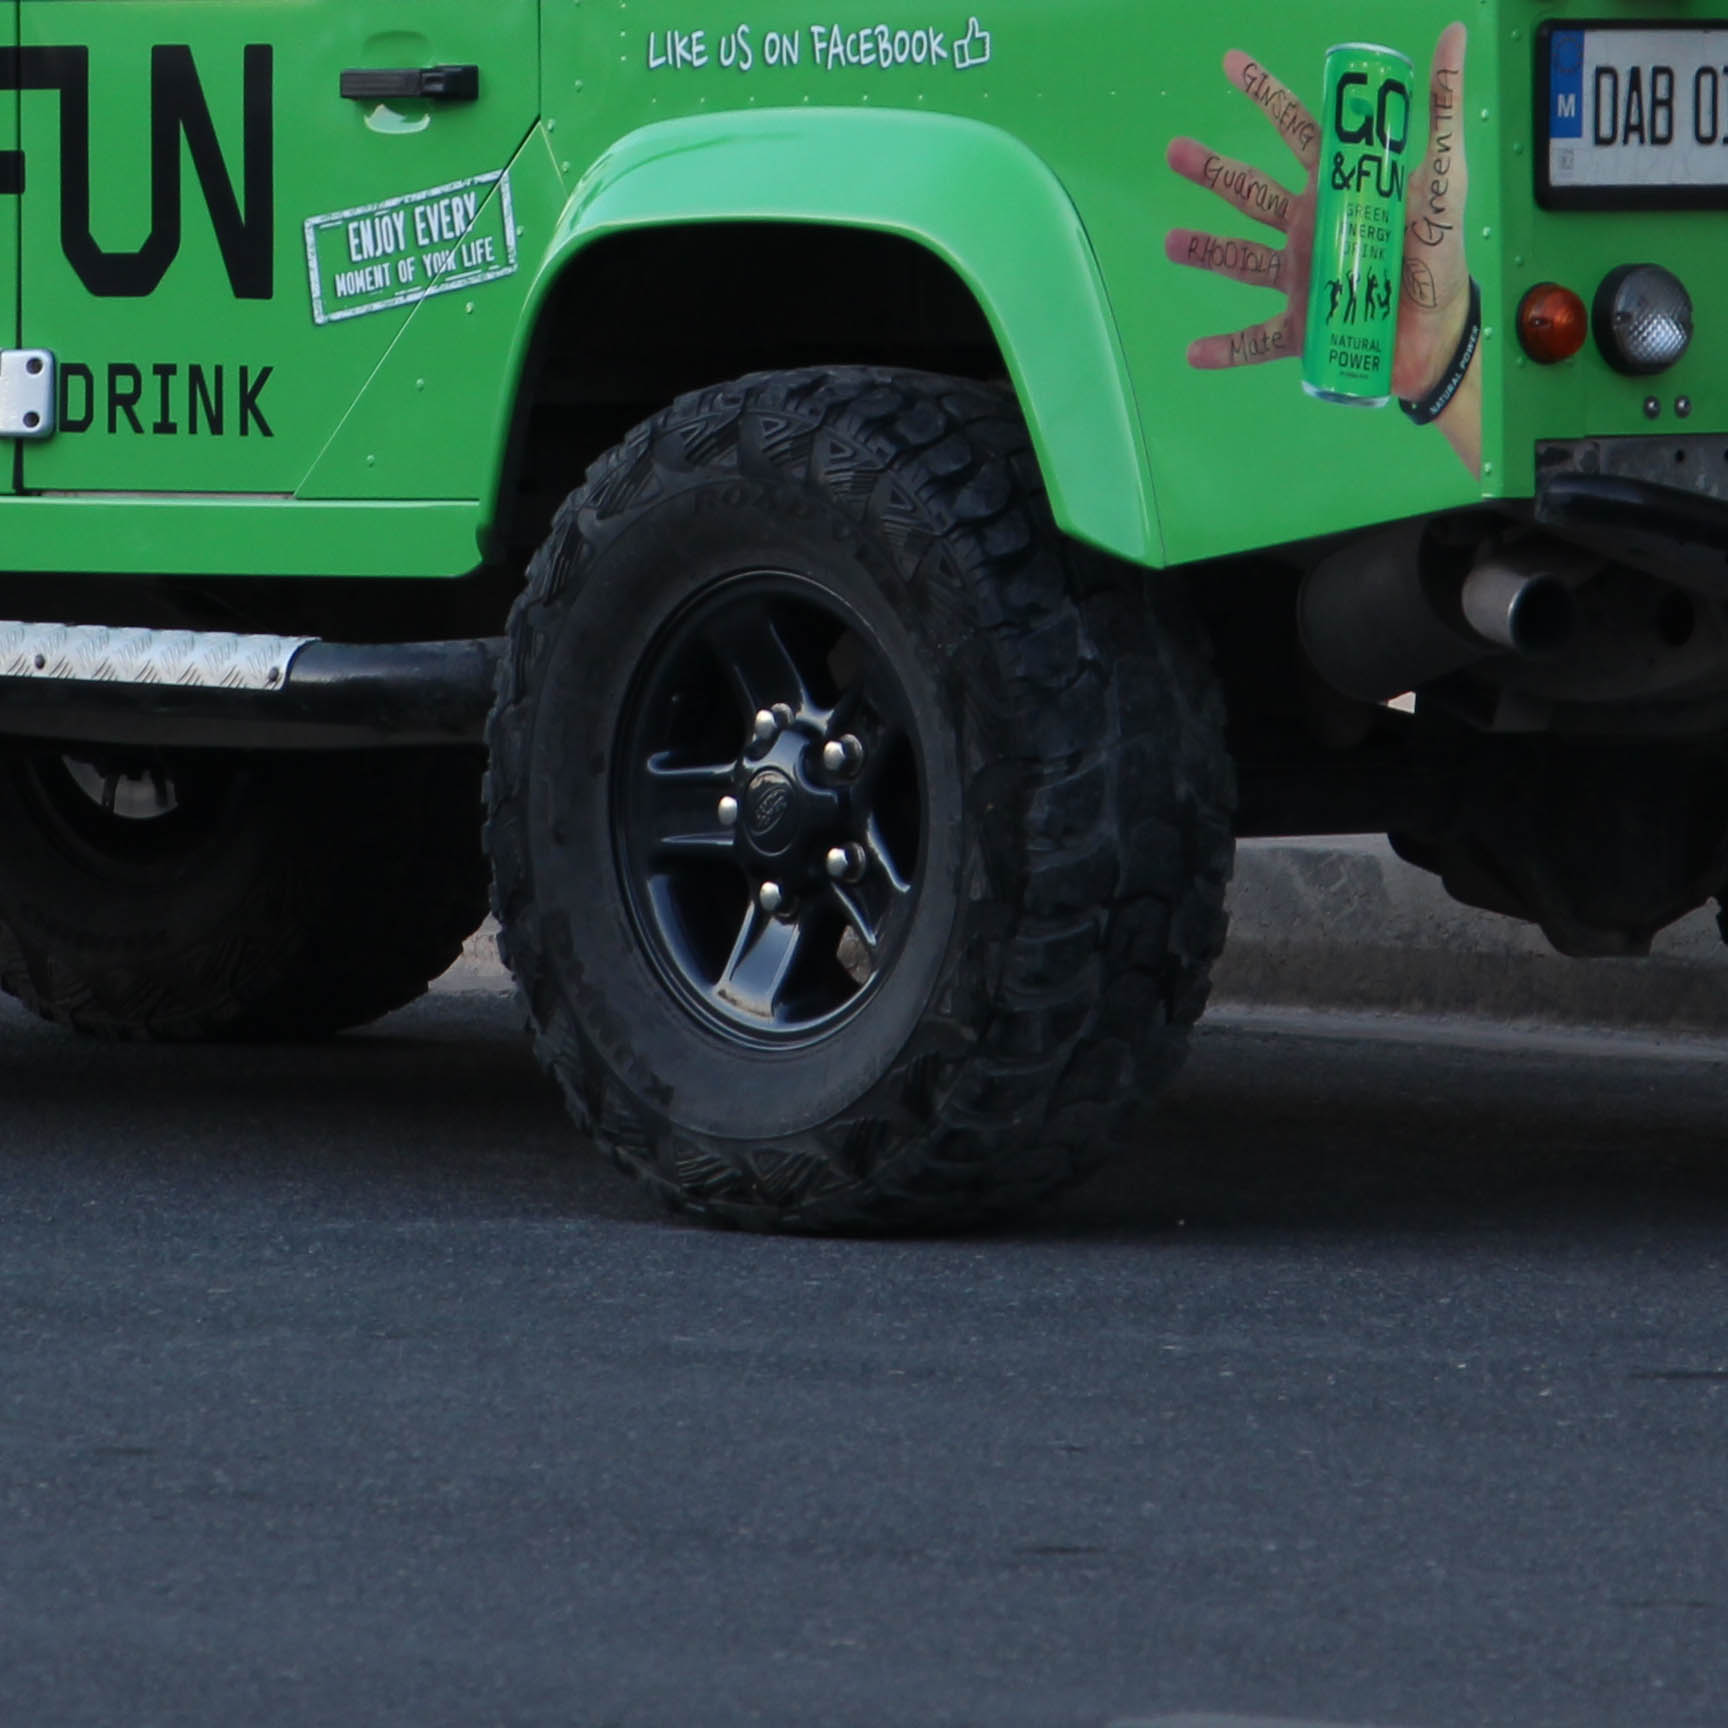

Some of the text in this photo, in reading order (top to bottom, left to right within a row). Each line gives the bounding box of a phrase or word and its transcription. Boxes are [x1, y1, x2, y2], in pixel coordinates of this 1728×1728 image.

[648, 23, 948, 71] LIKE US ON FACEBOOK
[1335, 72, 1410, 155] GO
[1557, 93, 1576, 118] M
[1594, 66, 1675, 146] DAB
[1331, 151, 1406, 203] &FUN
[348, 191, 477, 262] ENJOY EVERY
[335, 236, 495, 297] MOMENT OF YOUR LIFE
[1329, 350, 1380, 371] POWER
[1331, 333, 1382, 353] NATURAL
[58, 364, 275, 438] DRINK
[1429, 373, 1463, 416] NATURAL
